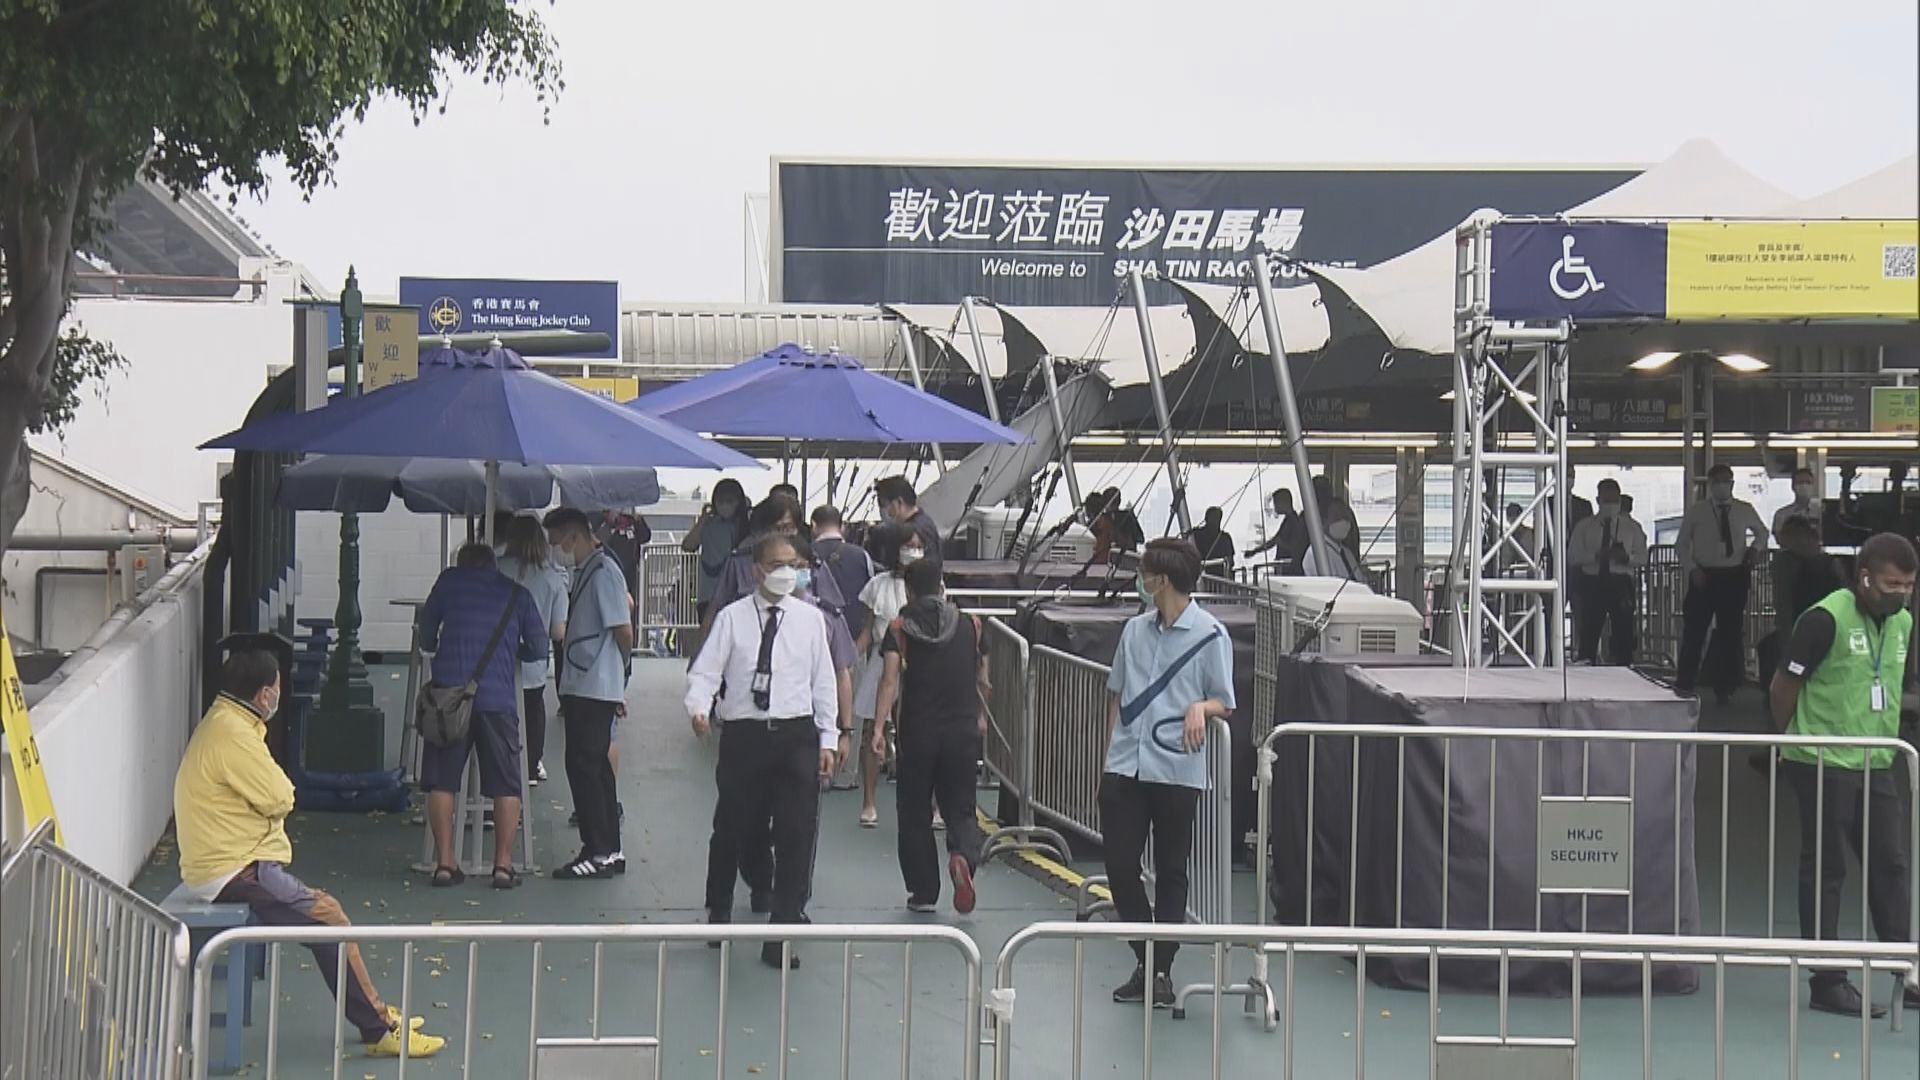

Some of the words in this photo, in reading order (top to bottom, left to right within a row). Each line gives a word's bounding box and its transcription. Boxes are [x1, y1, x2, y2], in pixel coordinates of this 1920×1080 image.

[883, 188, 1110, 246] 歡迎蒞臨
[1115, 207, 1304, 251] 沙田馬場
[980, 258, 1064, 278] Welcome
[1068, 259, 1087, 278] to
[1165, 260, 1201, 277] TIN
[472, 298, 540, 311] 香港賽馬會
[471, 313, 489, 325] The
[490, 313, 514, 328] Hong
[515, 313, 538, 328] Kong
[539, 313, 568, 328] Jockey
[569, 314, 591, 326] Club
[1567, 828, 1603, 841] HKJC
[1550, 849, 1619, 863] SECURITY
